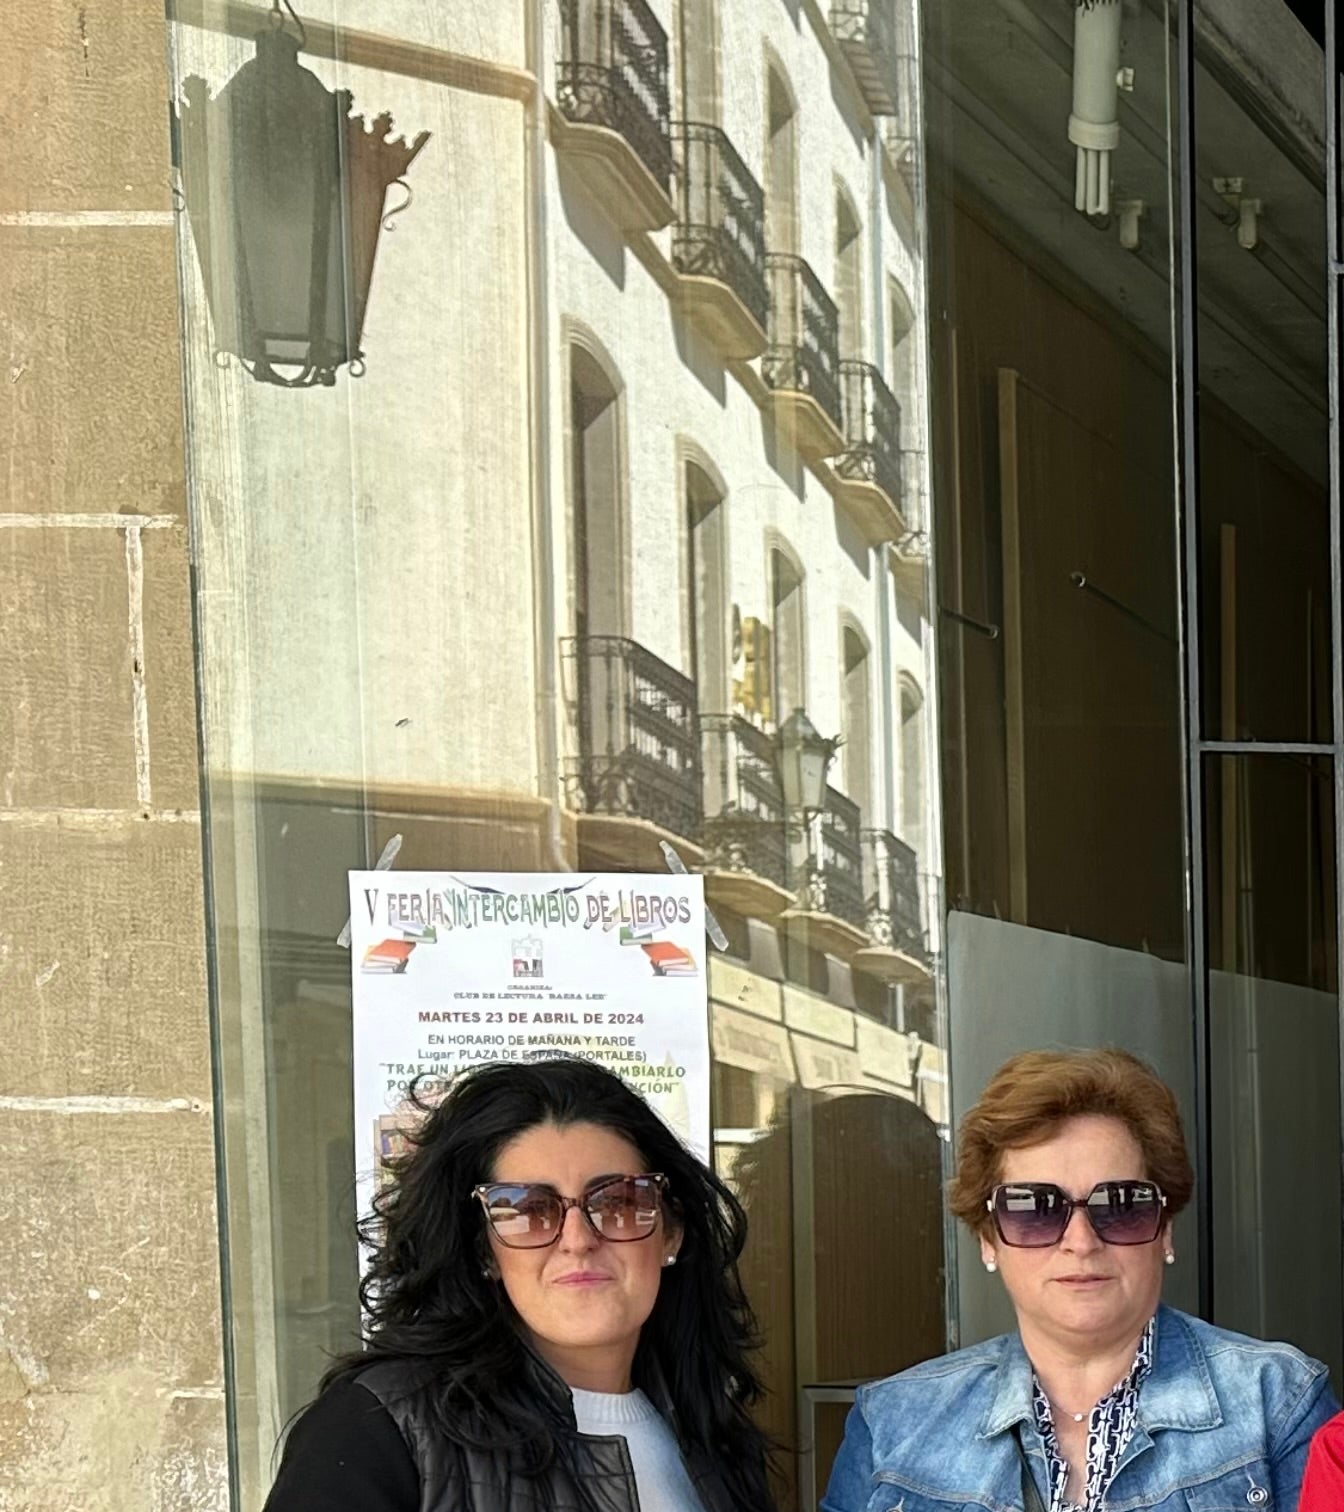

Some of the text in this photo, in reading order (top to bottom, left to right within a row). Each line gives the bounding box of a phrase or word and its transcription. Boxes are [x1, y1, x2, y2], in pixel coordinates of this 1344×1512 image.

[364, 889, 379, 925] V
[584, 894, 613, 930] DE
[618, 891, 692, 927] LIBROS
[418, 1012, 644, 1024] MARTES 23 DE ABRIL DE 2024
[428, 1033, 636, 1046] EN HORARIO DE MAÑANA Y TARDE
